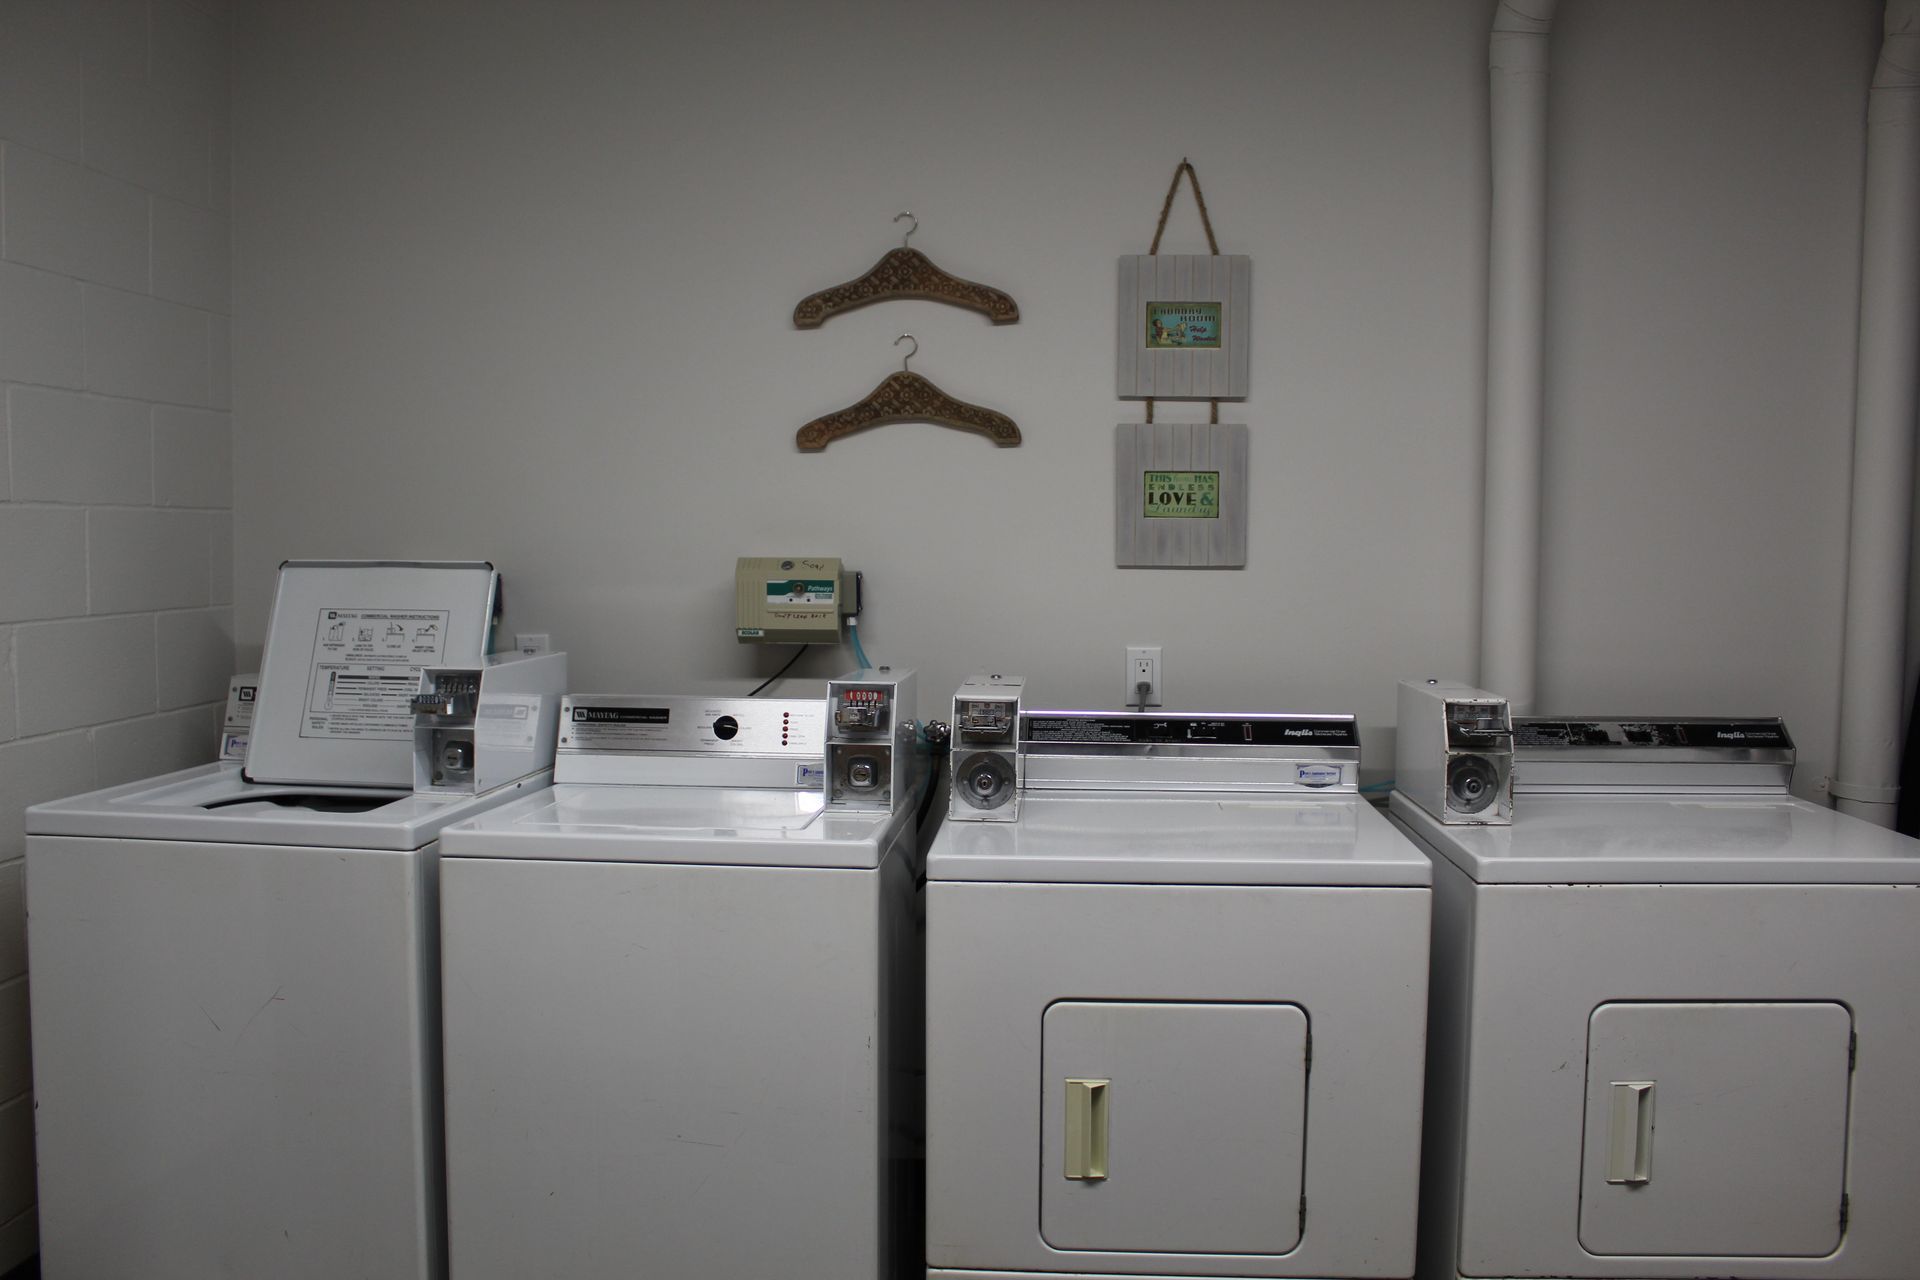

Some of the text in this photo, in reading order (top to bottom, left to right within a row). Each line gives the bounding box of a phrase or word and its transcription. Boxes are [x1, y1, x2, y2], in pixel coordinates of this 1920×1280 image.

[1194, 475, 1214, 483] HAS
[1148, 483, 1214, 491] ENDLESS
[1148, 492, 1214, 505] LOVE &
[807, 585, 833, 593] Pathways
[587, 711, 620, 720] MAYTAG
[1284, 728, 1313, 737] Inglis
[1716, 731, 1745, 740] Inglis
